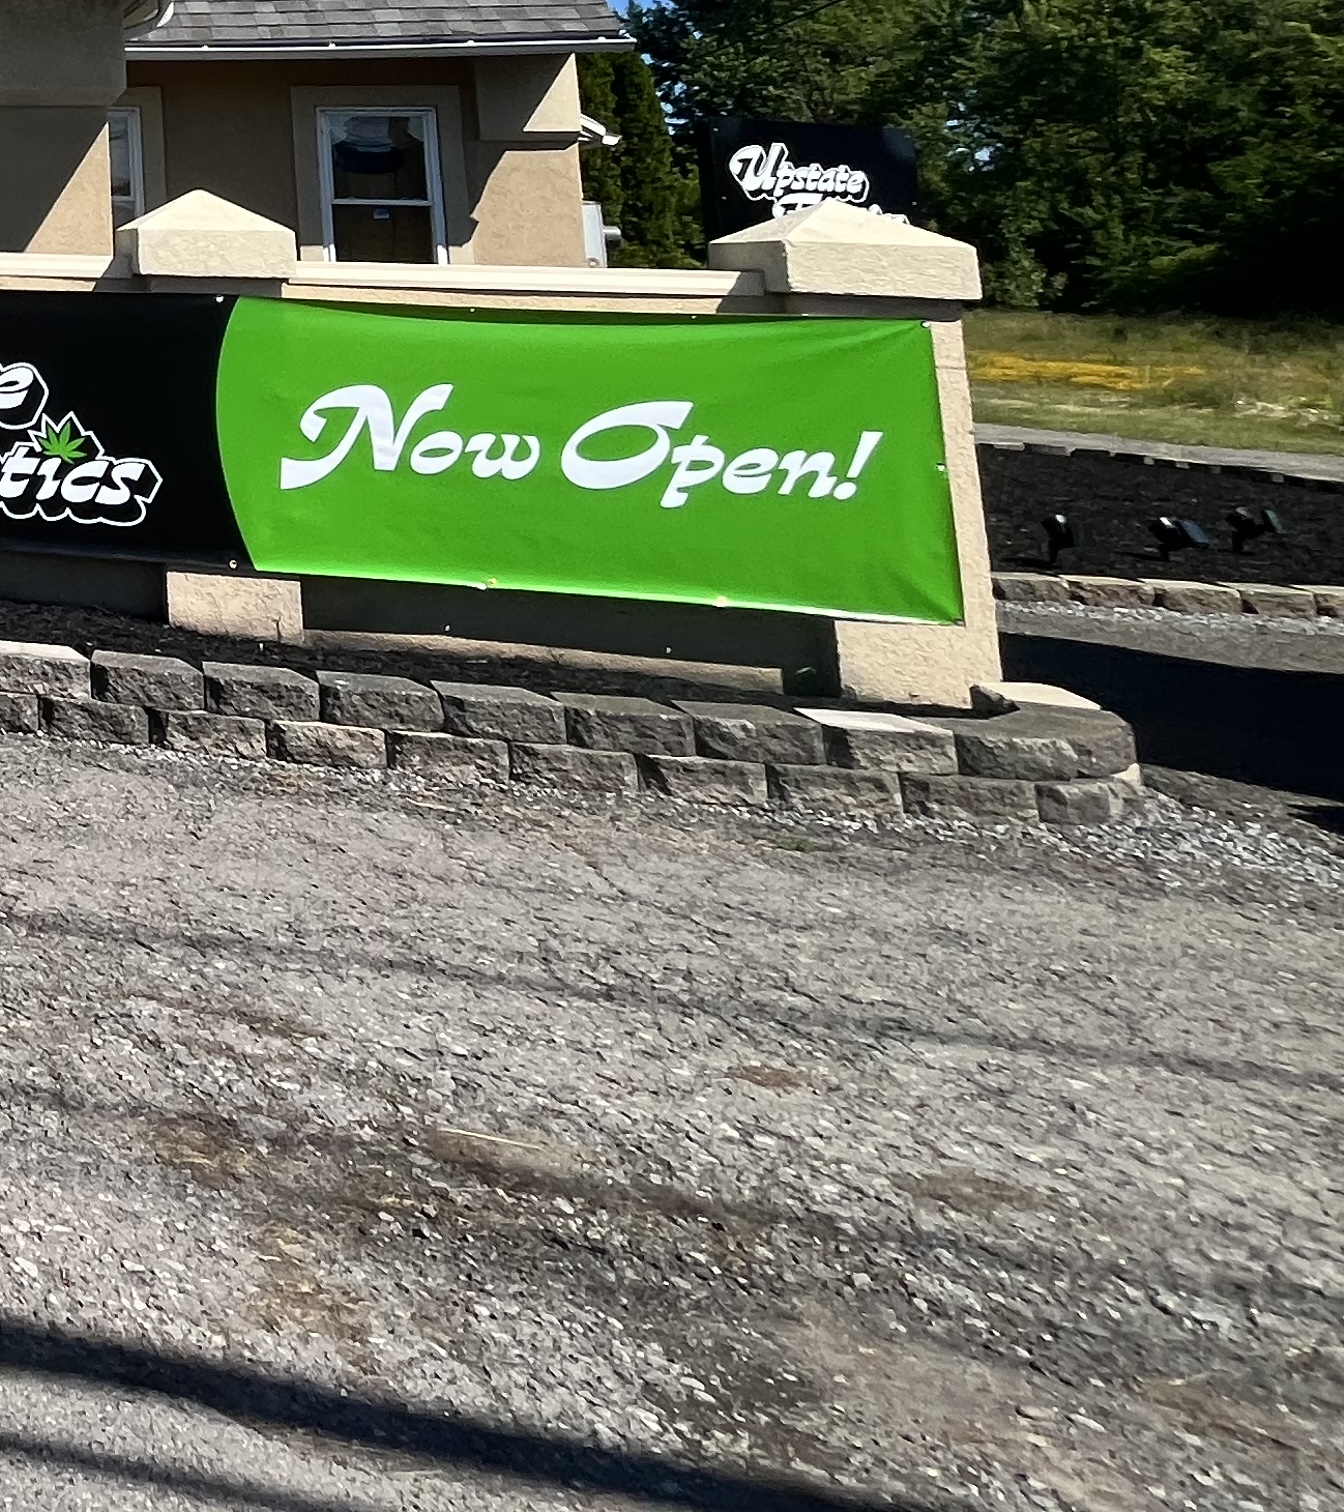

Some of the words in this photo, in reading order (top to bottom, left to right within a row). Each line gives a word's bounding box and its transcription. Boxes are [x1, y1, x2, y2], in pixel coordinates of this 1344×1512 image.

[729, 143, 868, 200] Upstate
[280, 383, 540, 489] Now
[561, 400, 883, 508] Open!
